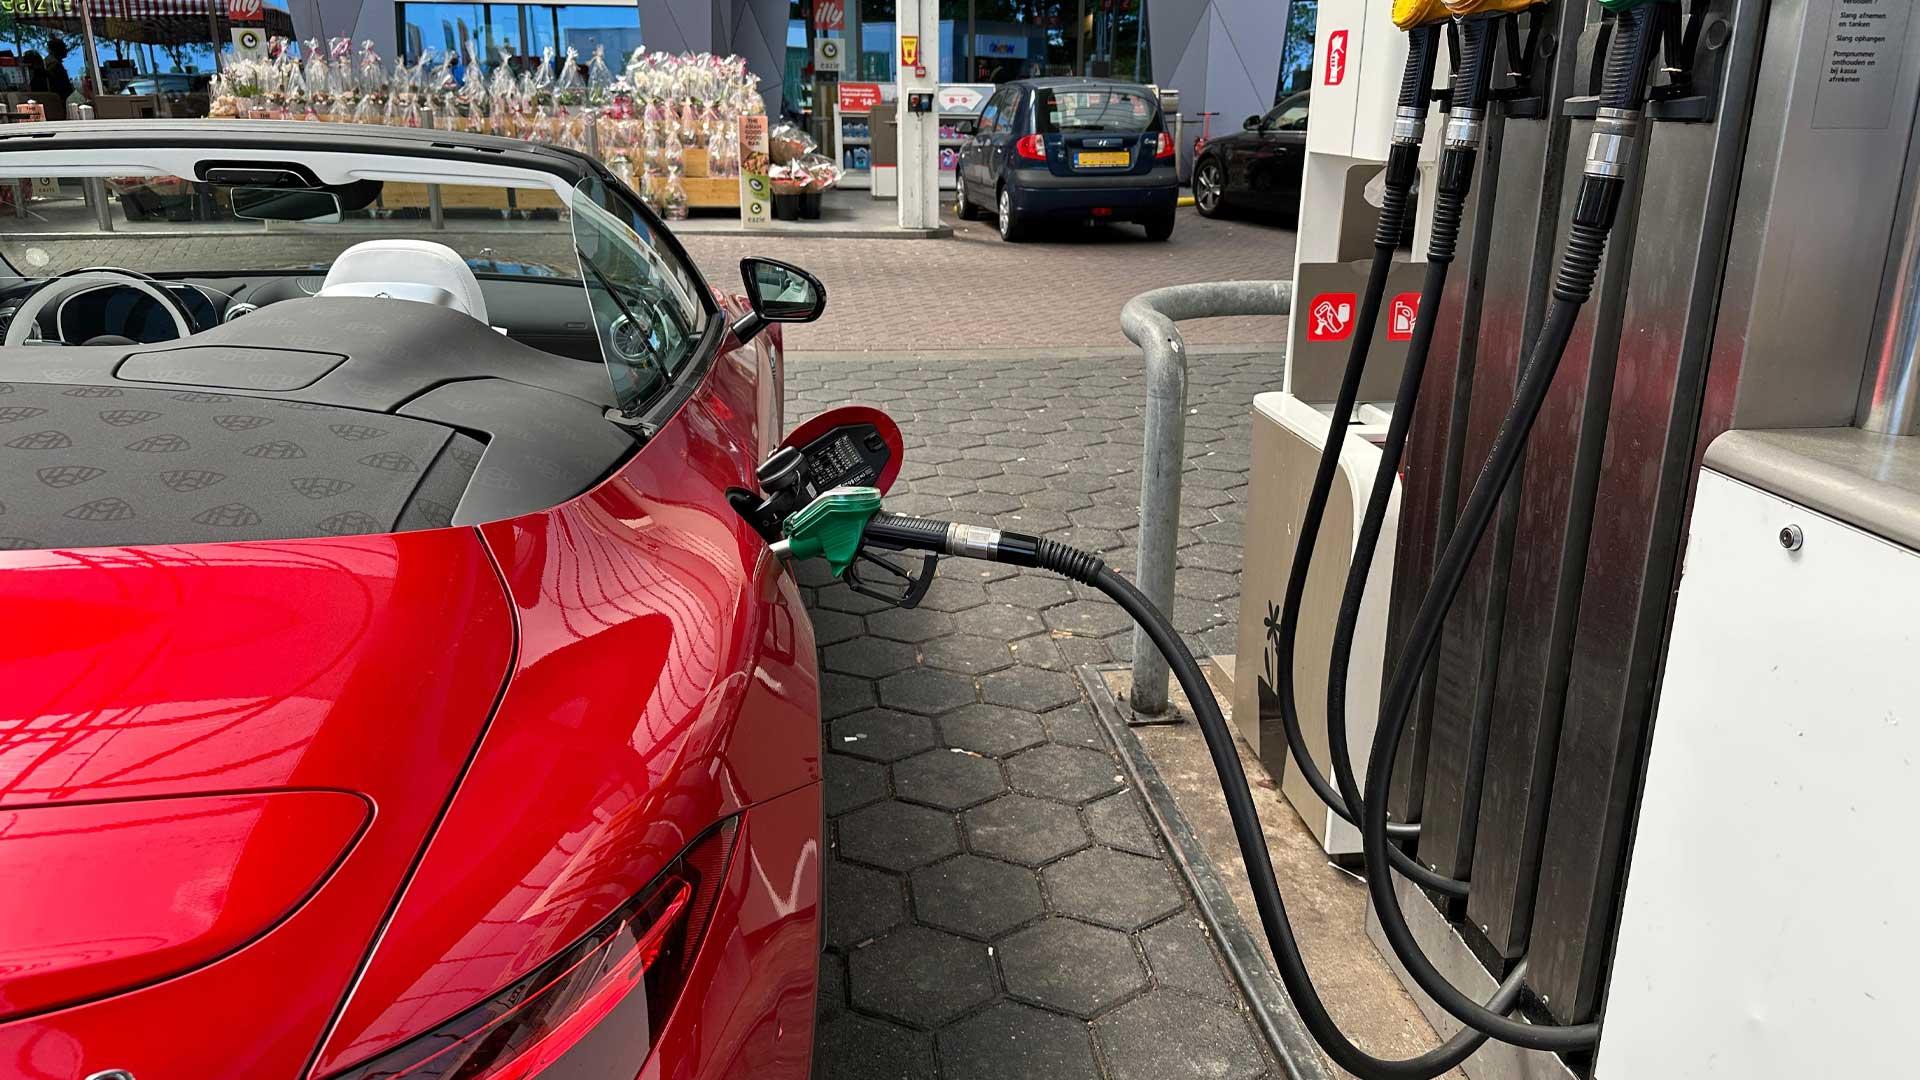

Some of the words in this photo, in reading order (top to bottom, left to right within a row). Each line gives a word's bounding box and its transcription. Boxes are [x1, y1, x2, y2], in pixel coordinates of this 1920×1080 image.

[815, 2, 843, 27] illy
[1840, 12, 1857, 20] Slang
[1836, 35, 1853, 43] Slang
[1854, 35, 1886, 43] ophangen
